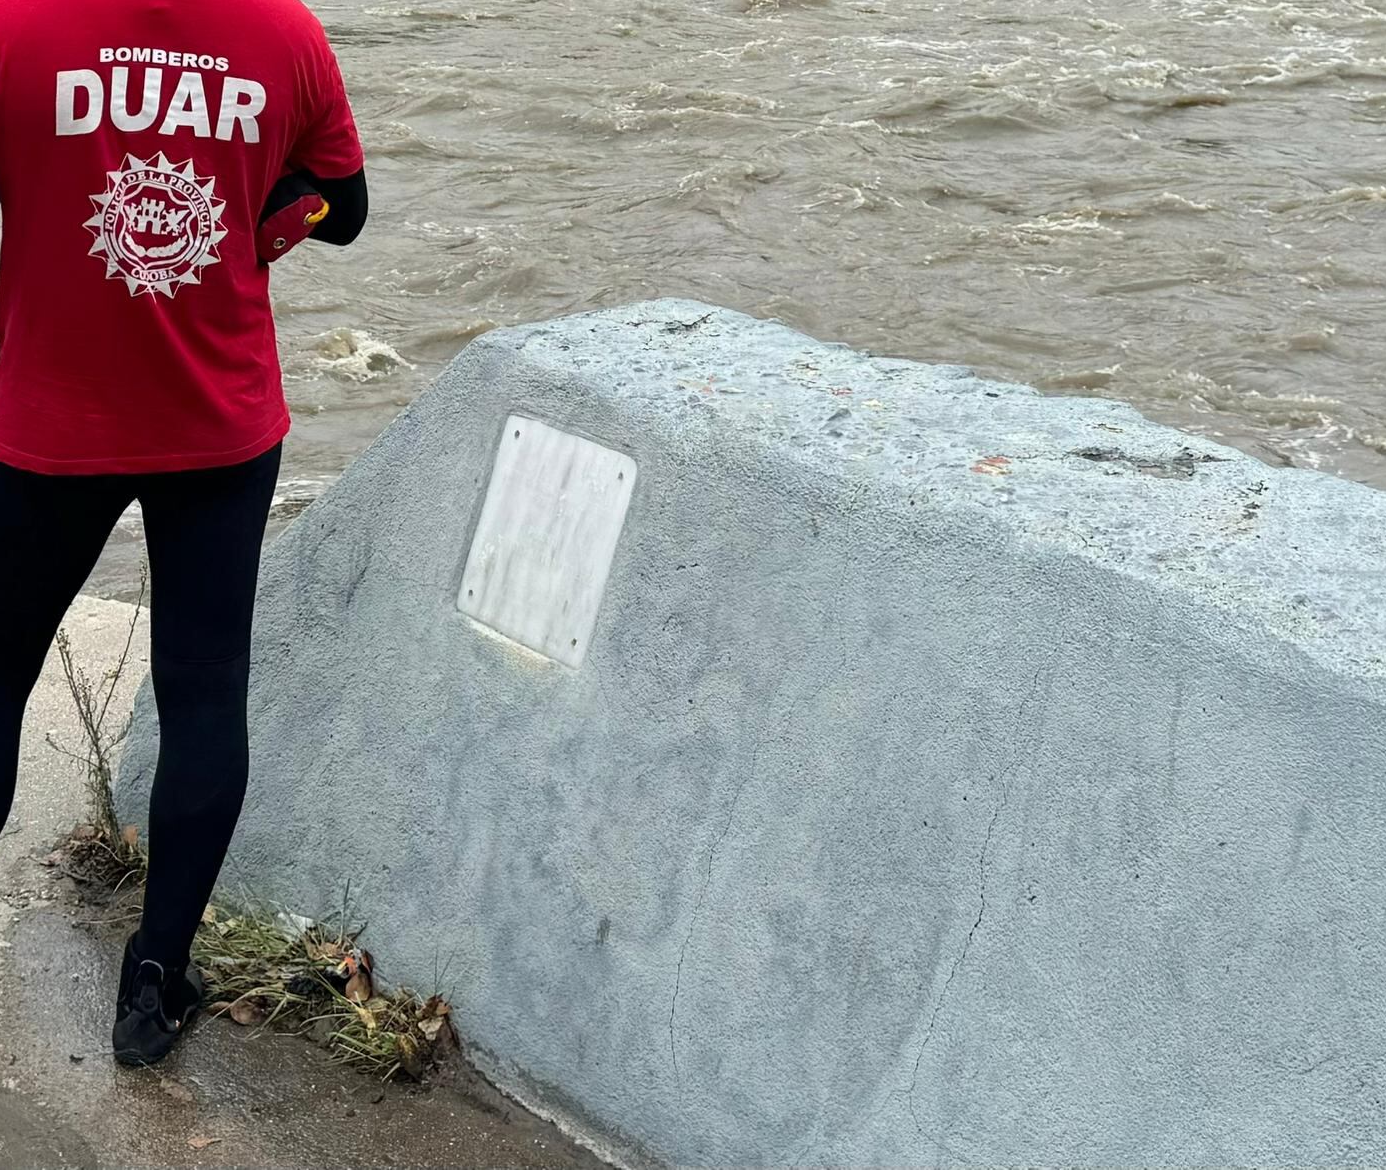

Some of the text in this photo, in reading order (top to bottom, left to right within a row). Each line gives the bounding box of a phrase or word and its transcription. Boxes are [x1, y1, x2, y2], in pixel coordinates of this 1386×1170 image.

[100, 47, 229, 72] BOMBEROS
[56, 66, 267, 143] DUAR
[126, 171, 146, 185] DE
[149, 172, 166, 184] LA
[169, 176, 211, 235] PROVINCIA
